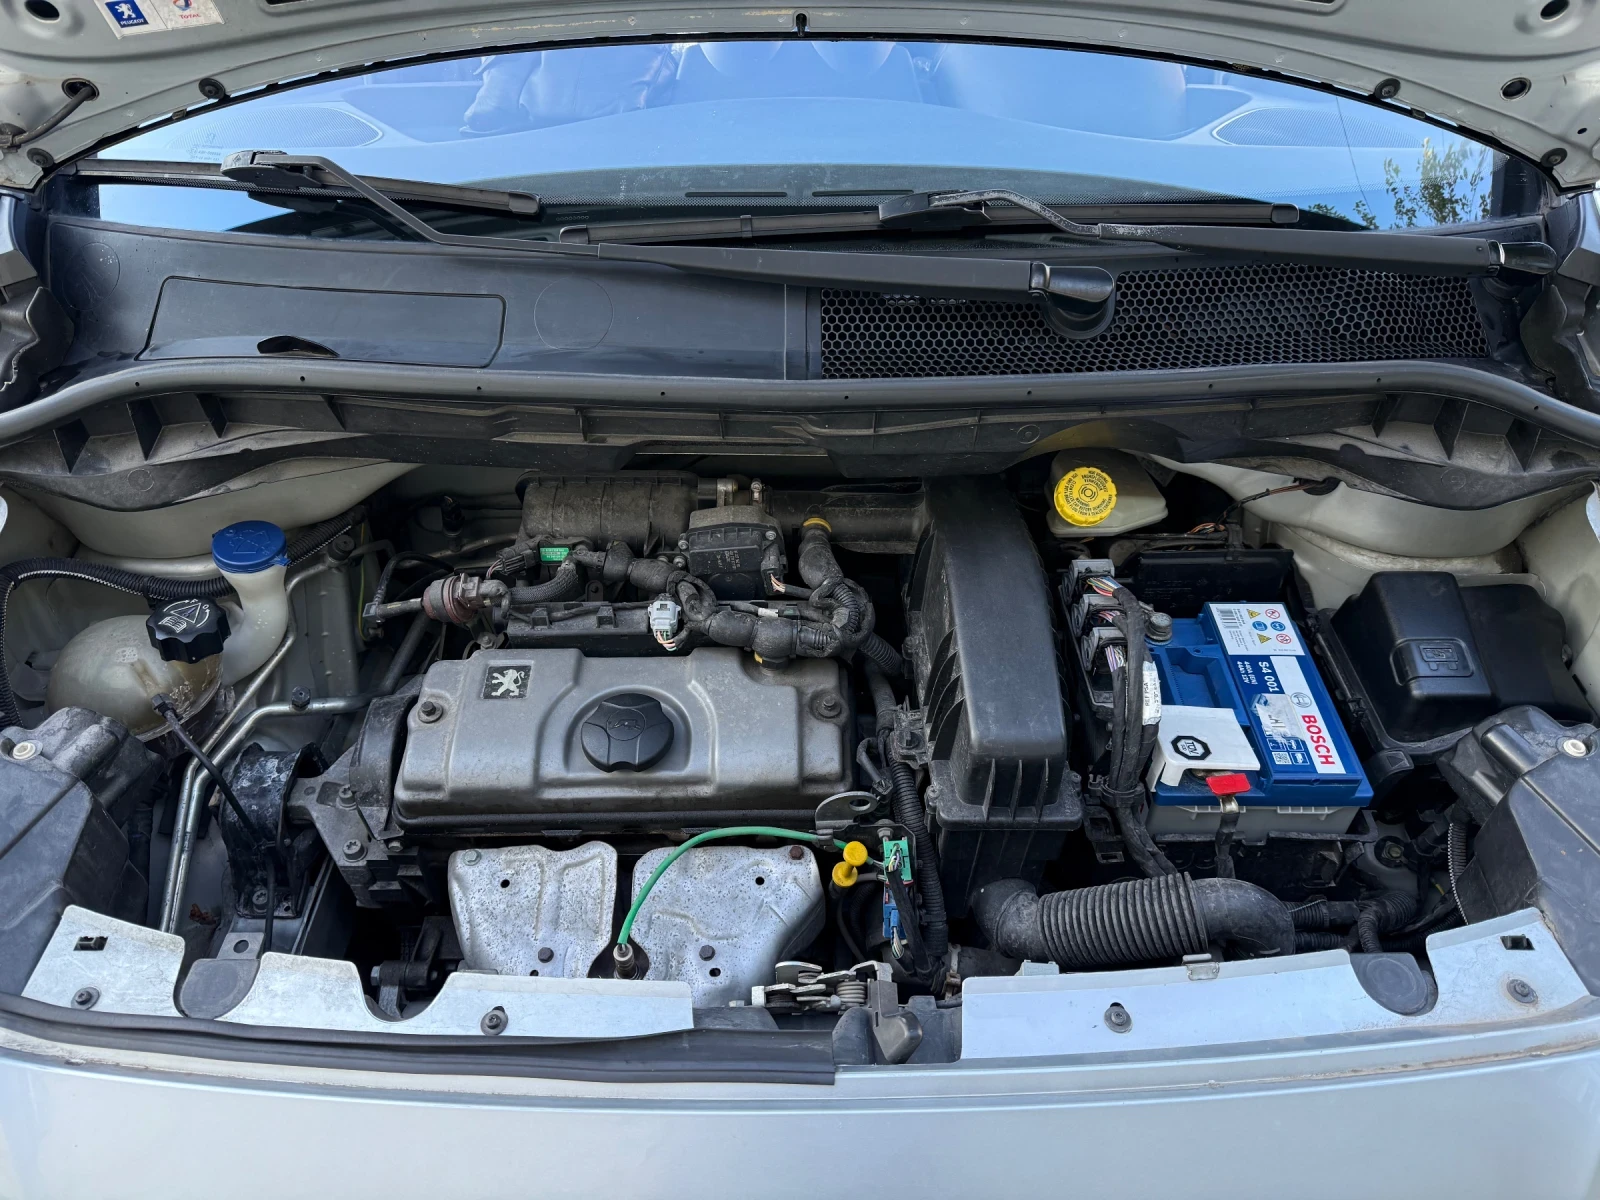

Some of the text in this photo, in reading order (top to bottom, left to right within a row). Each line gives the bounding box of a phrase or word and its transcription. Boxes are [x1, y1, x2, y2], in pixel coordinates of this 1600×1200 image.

[120, 18, 145, 26] PEUGEOT
[1258, 661, 1280, 693] S4 001
[1301, 714, 1336, 766] BOSCH
